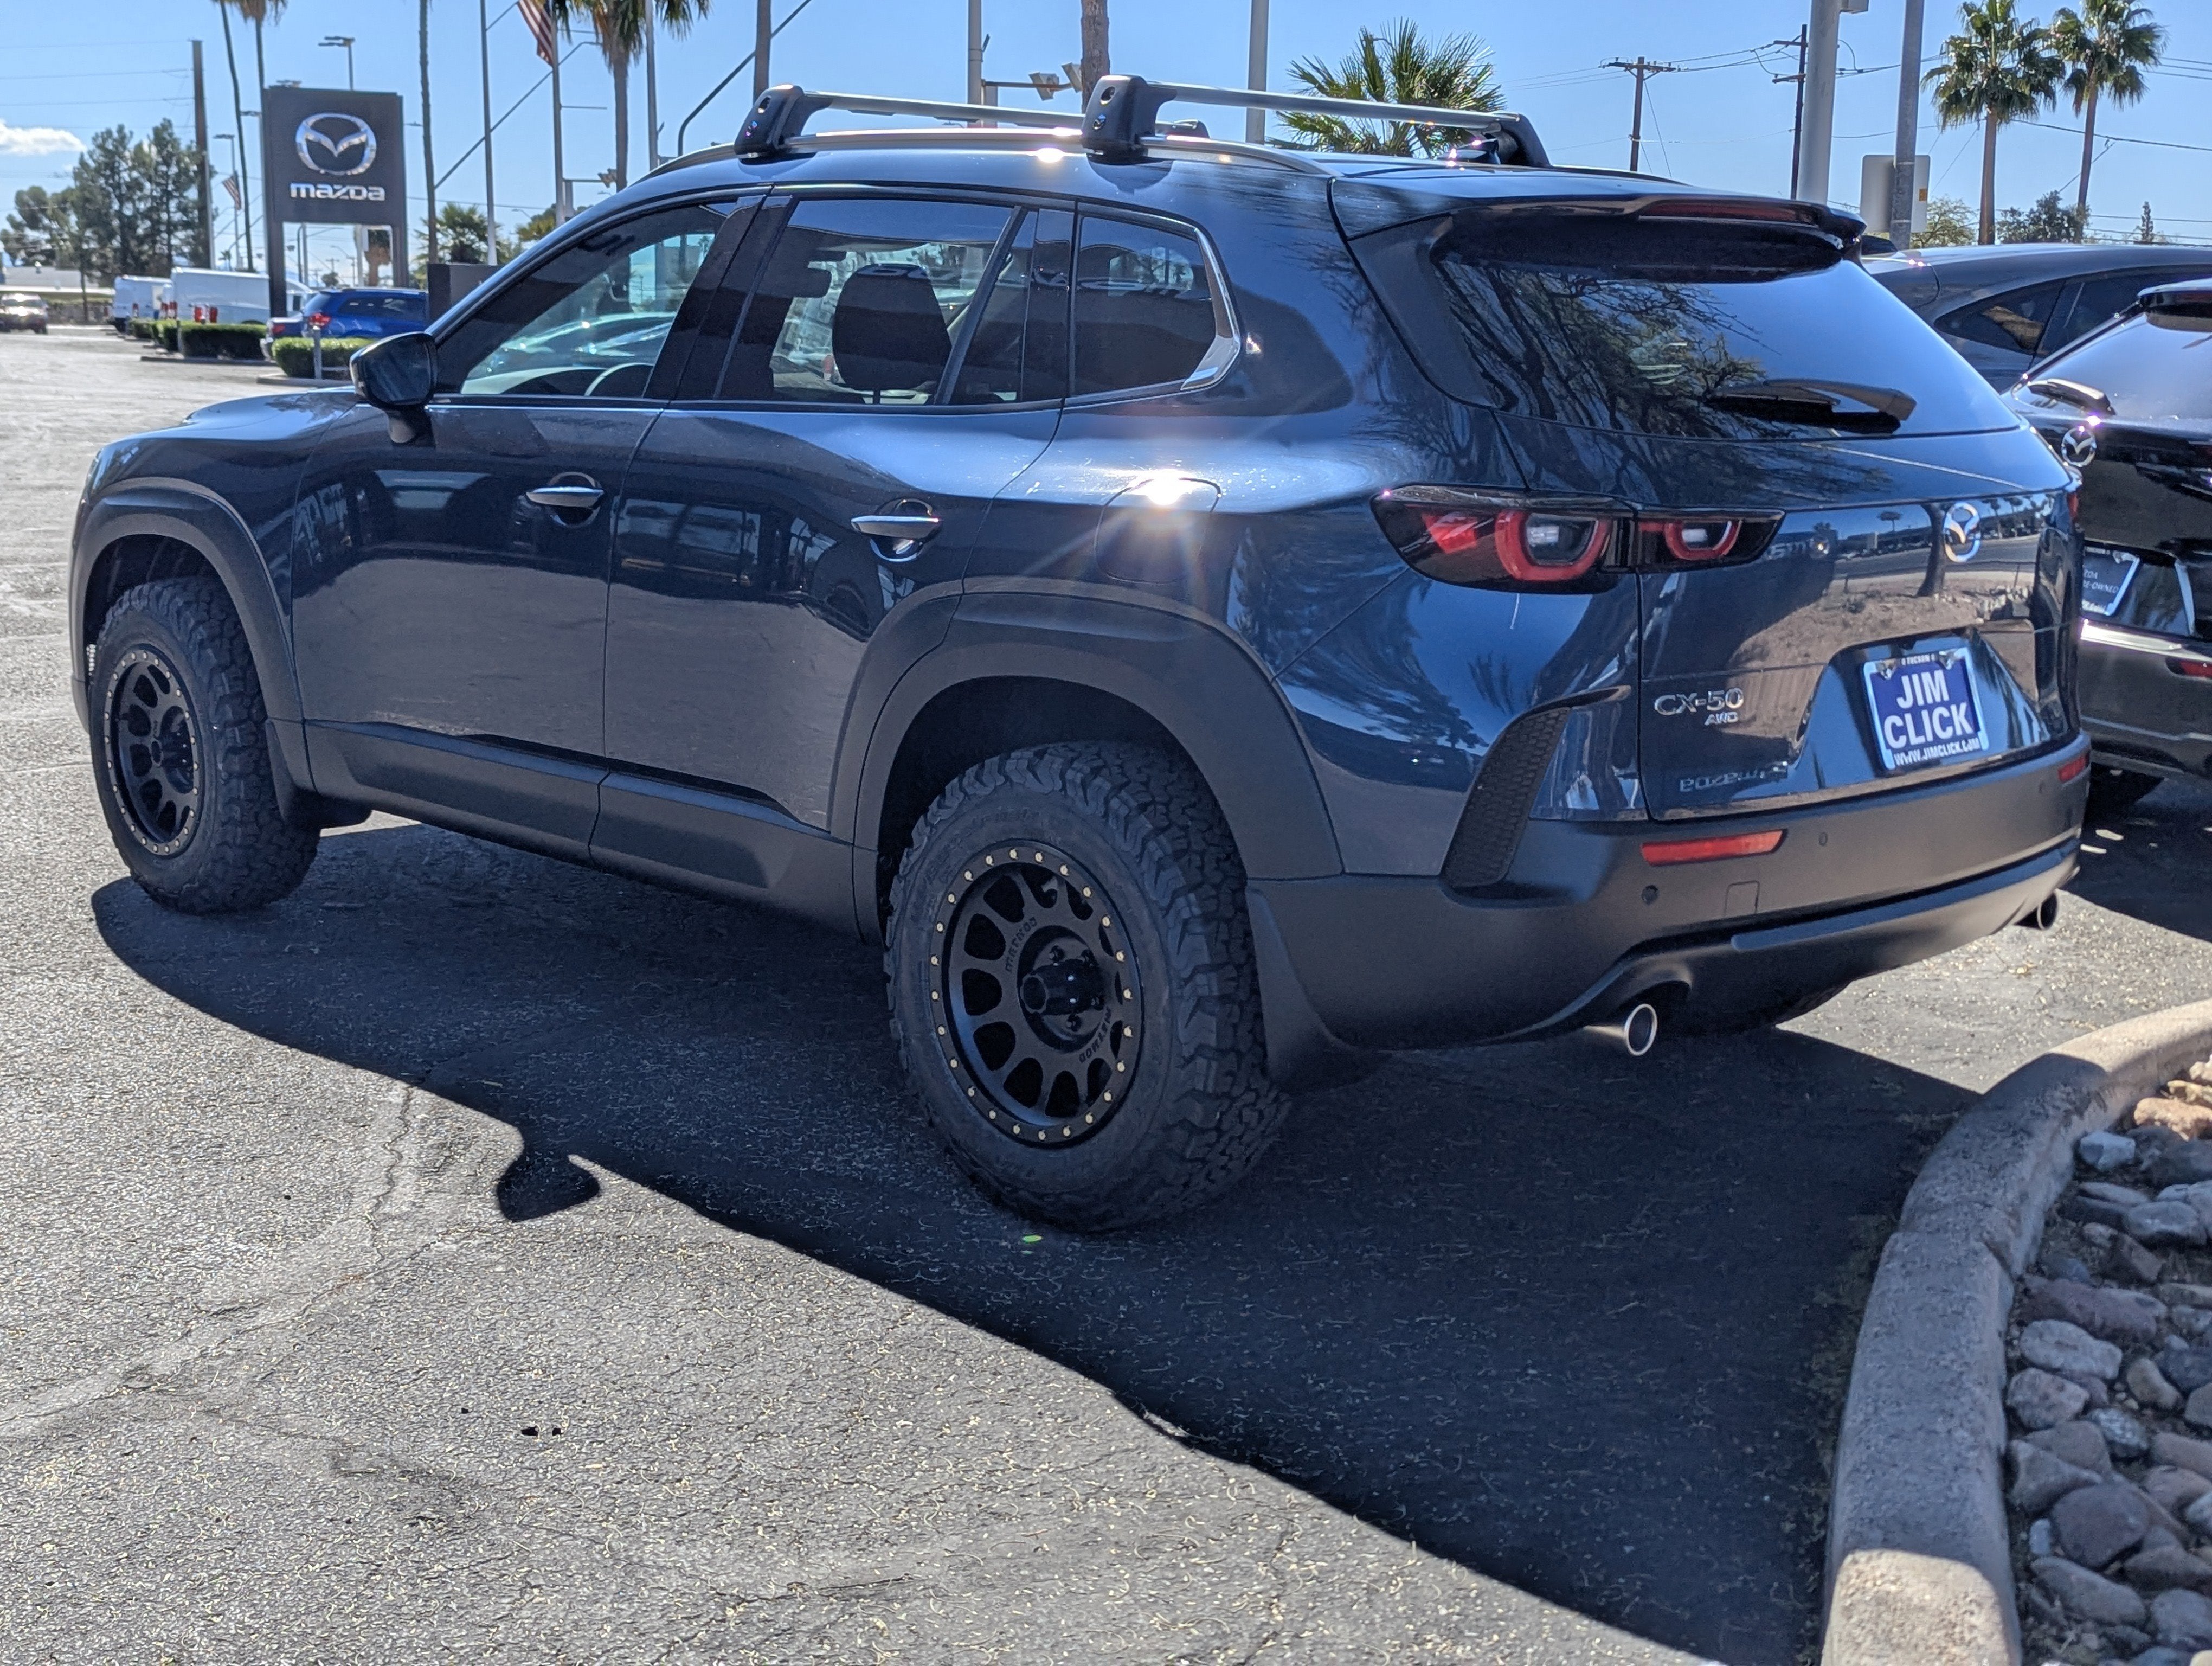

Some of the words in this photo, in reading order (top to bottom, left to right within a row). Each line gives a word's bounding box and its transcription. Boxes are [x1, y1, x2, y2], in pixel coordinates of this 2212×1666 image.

[290, 182, 385, 201] mazda
[2083, 579, 2119, 594] RE-OWNED
[1896, 670, 1950, 709] JIM
[1655, 688, 1744, 715] CX-50
[1705, 712, 1738, 726] AWD
[1884, 702, 1974, 749] CLICK
